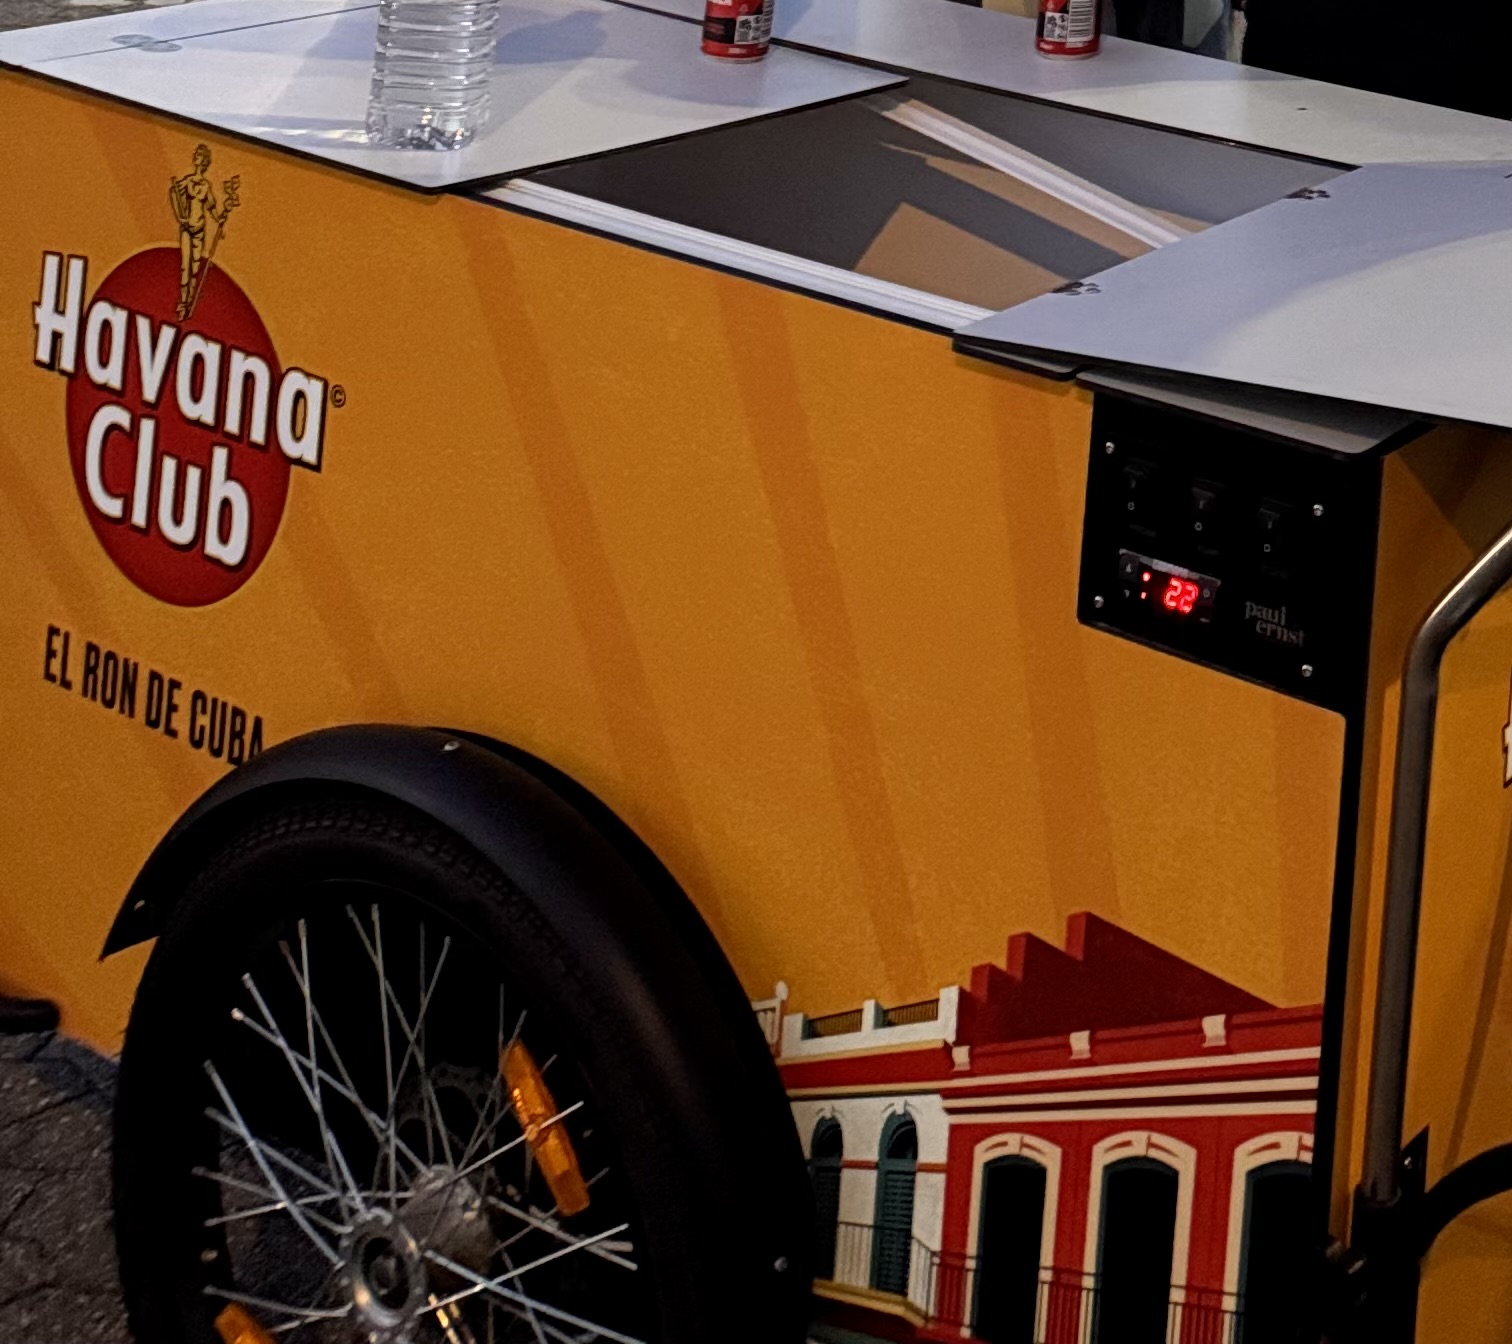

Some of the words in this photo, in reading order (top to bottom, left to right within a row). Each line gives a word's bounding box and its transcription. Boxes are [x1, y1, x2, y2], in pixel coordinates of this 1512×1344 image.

[33, 250, 328, 472] Havana
[83, 402, 253, 571] Club
[1163, 577, 1199, 614] 22
[1244, 600, 1287, 626] paul
[1256, 619, 1305, 647] ernst
[43, 623, 72, 691] EL
[82, 640, 138, 720] RON
[145, 669, 182, 739] DE
